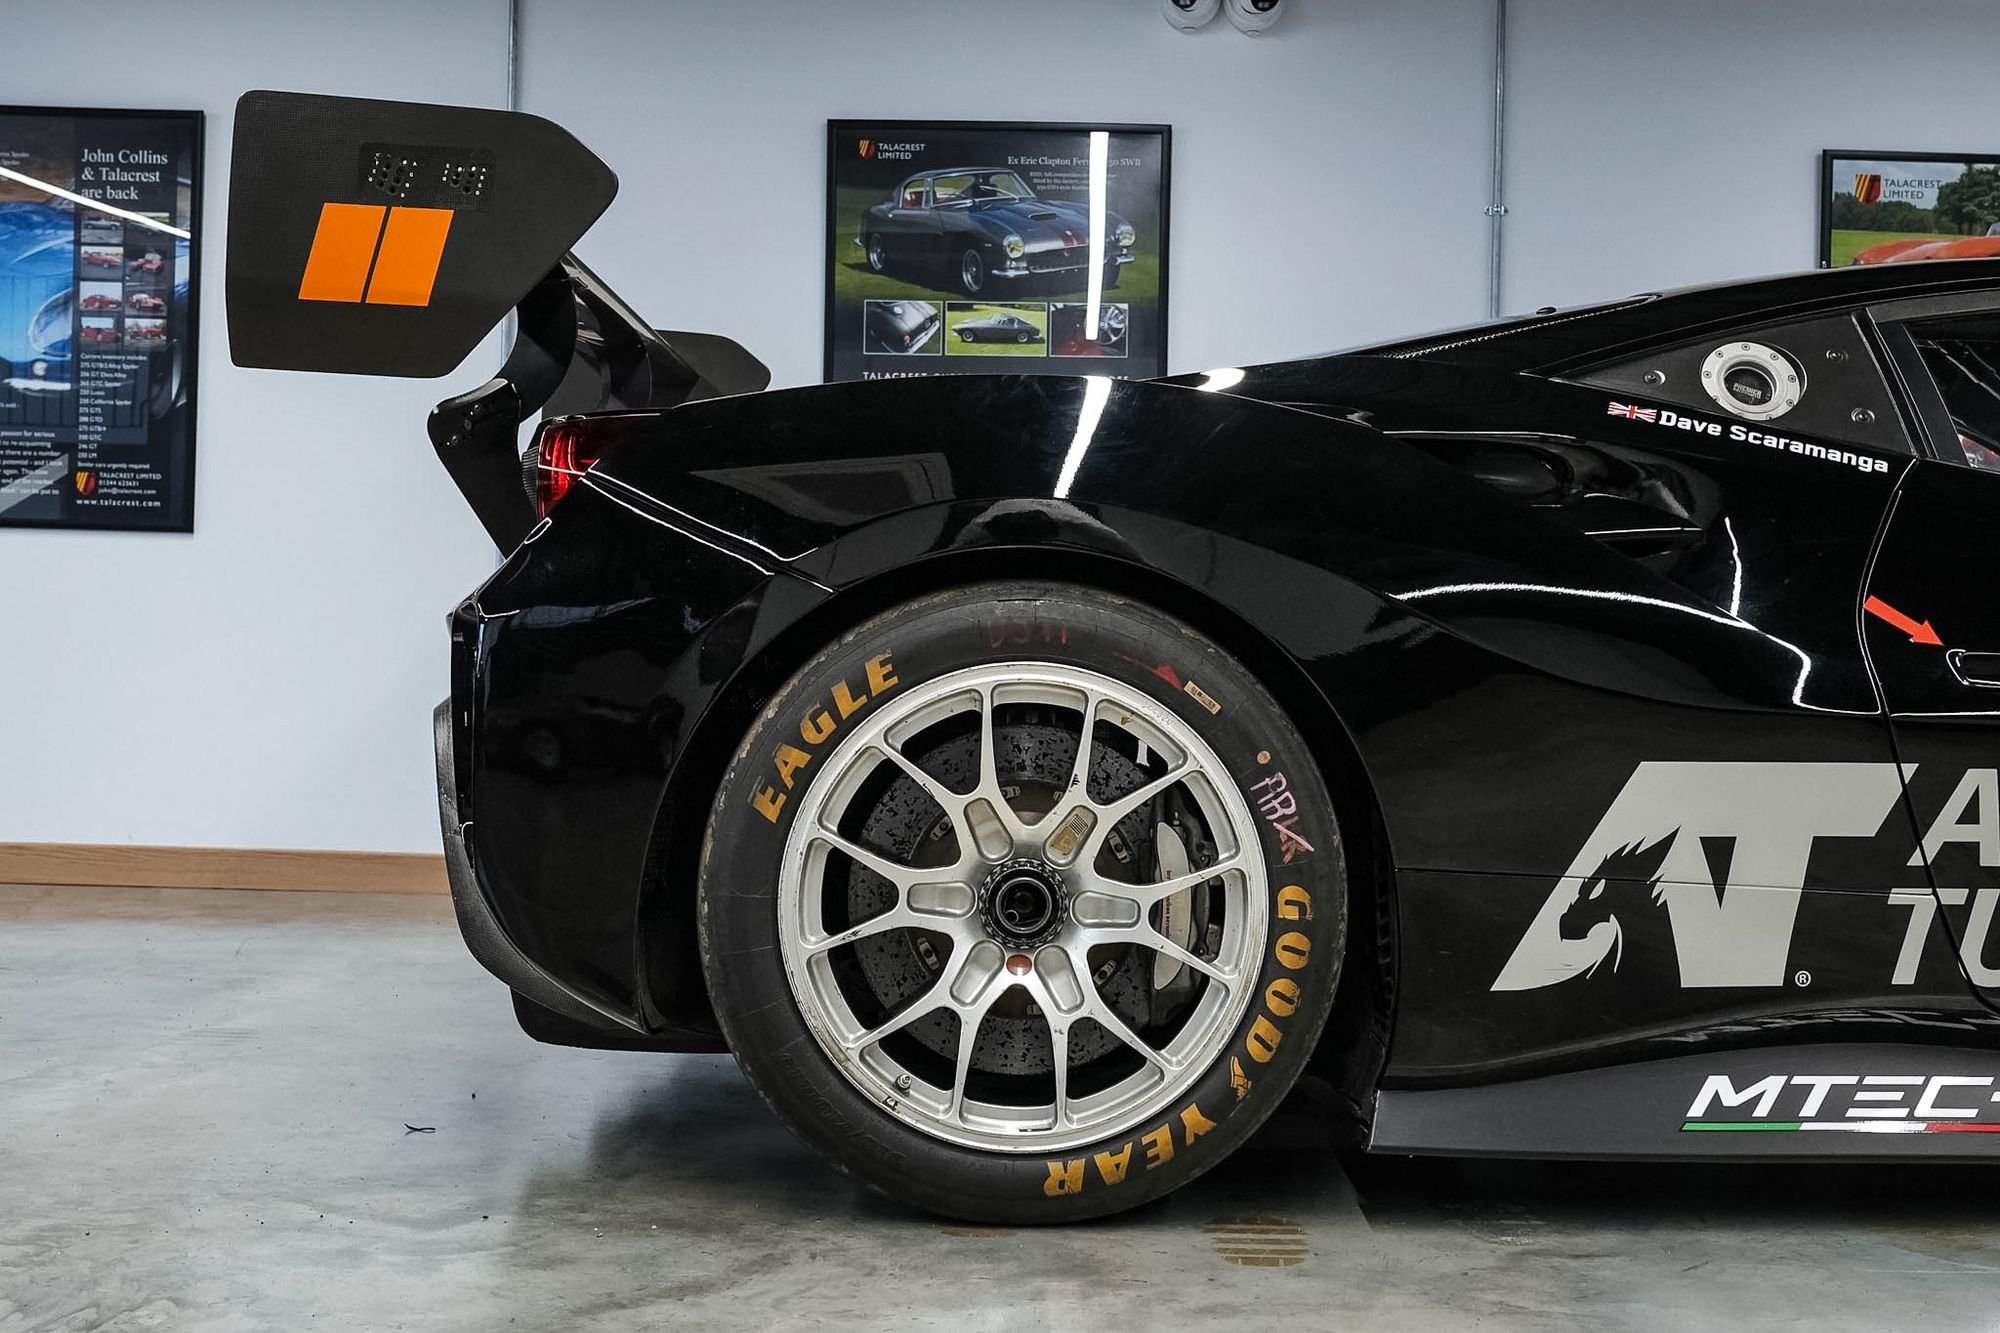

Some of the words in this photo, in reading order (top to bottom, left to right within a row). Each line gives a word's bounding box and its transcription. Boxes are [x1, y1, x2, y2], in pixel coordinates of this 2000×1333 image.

[877, 143, 926, 151] TALACREST
[81, 149, 114, 163] John
[118, 150, 168, 165] Collins
[877, 152, 912, 160] LIMITED
[1007, 155, 1019, 165] Ex
[1020, 156, 1038, 165] Eric
[1038, 156, 1071, 167] Clapton
[81, 167, 95, 180] &
[99, 168, 161, 182] Talacrest
[1883, 178, 1942, 188] TALACREST
[81, 188, 103, 199] are
[106, 186, 139, 200] back
[1883, 190, 1924, 200] LIMITED
[1658, 410, 1722, 437] Dave
[1729, 425, 1889, 474] Scaramanga
[76, 498, 161, 507] www.talacrest.com
[752, 648, 899, 824] EAGLE
[1685, 1075, 2000, 1118] MTEC
